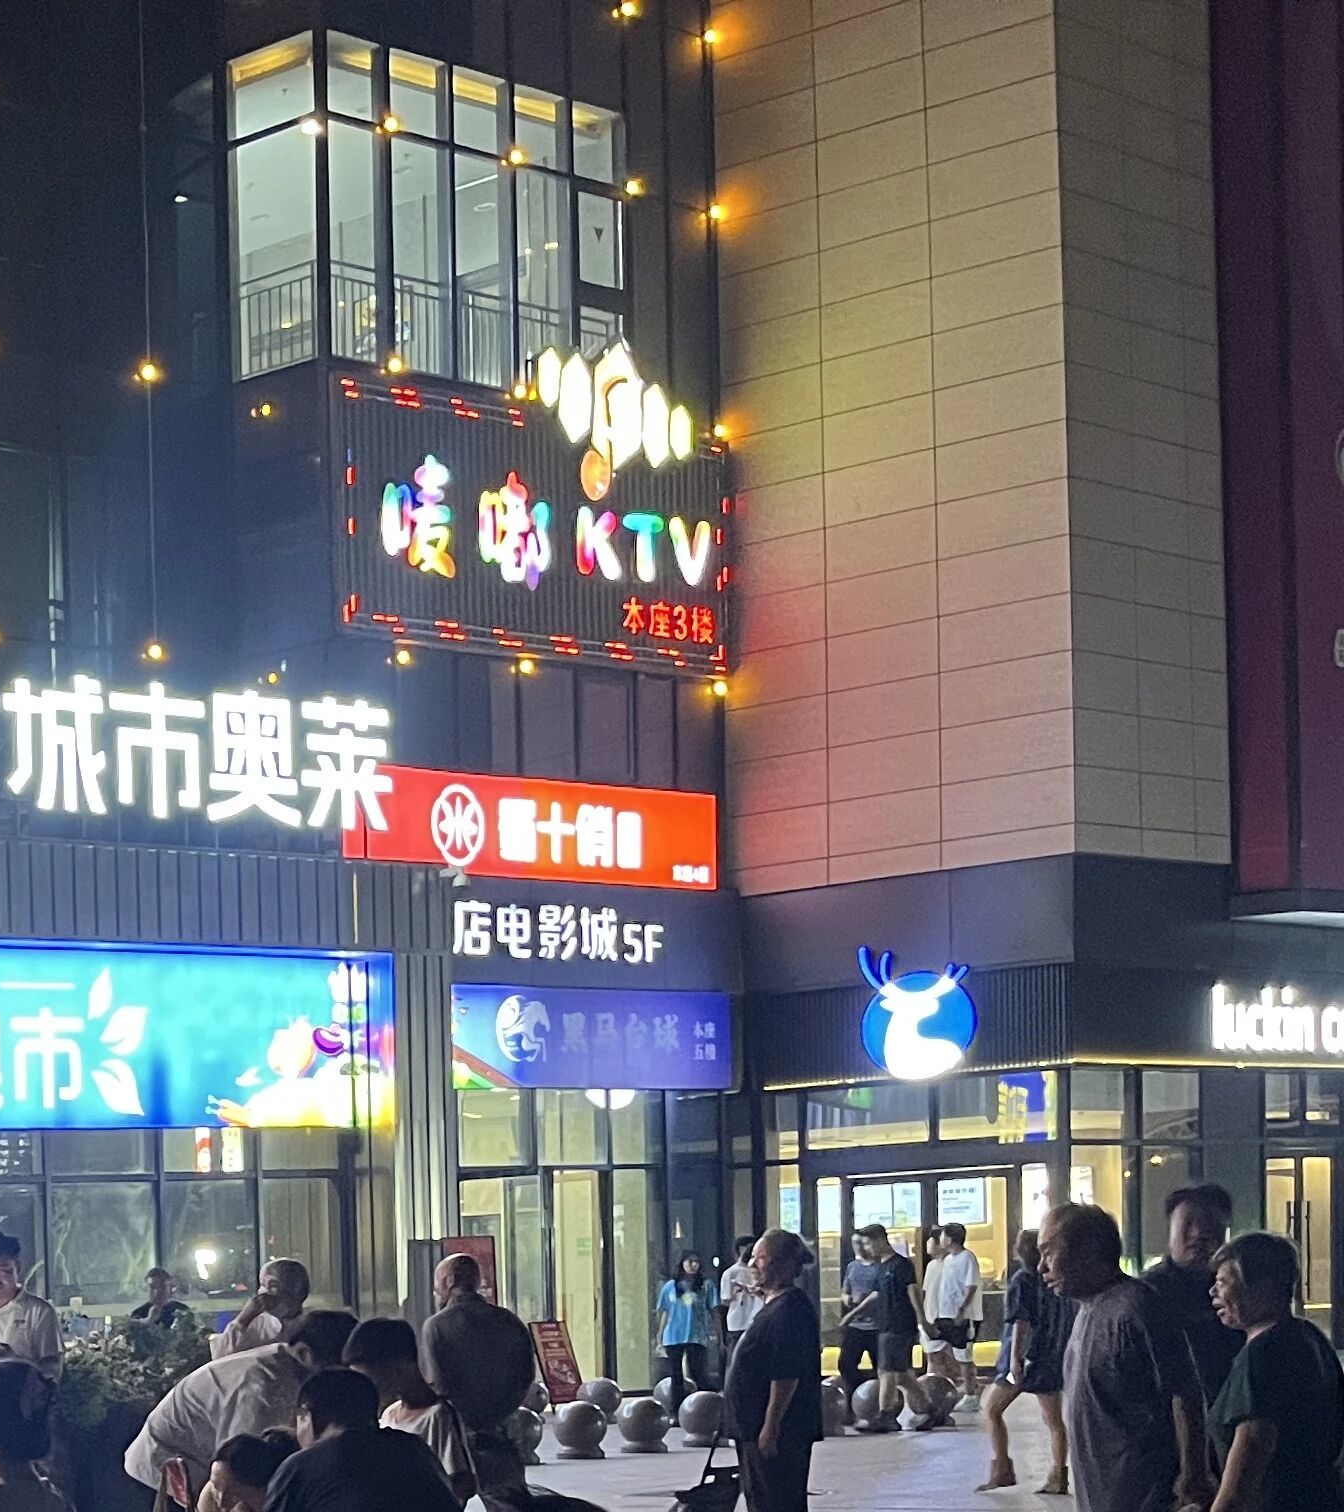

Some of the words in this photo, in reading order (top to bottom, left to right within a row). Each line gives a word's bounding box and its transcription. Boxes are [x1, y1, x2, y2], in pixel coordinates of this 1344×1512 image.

[575, 504, 711, 586] KTV
[622, 597, 714, 644] 本座3楼
[1, 675, 392, 832] 城市奥莱
[1212, 984, 1315, 1053] luckin
